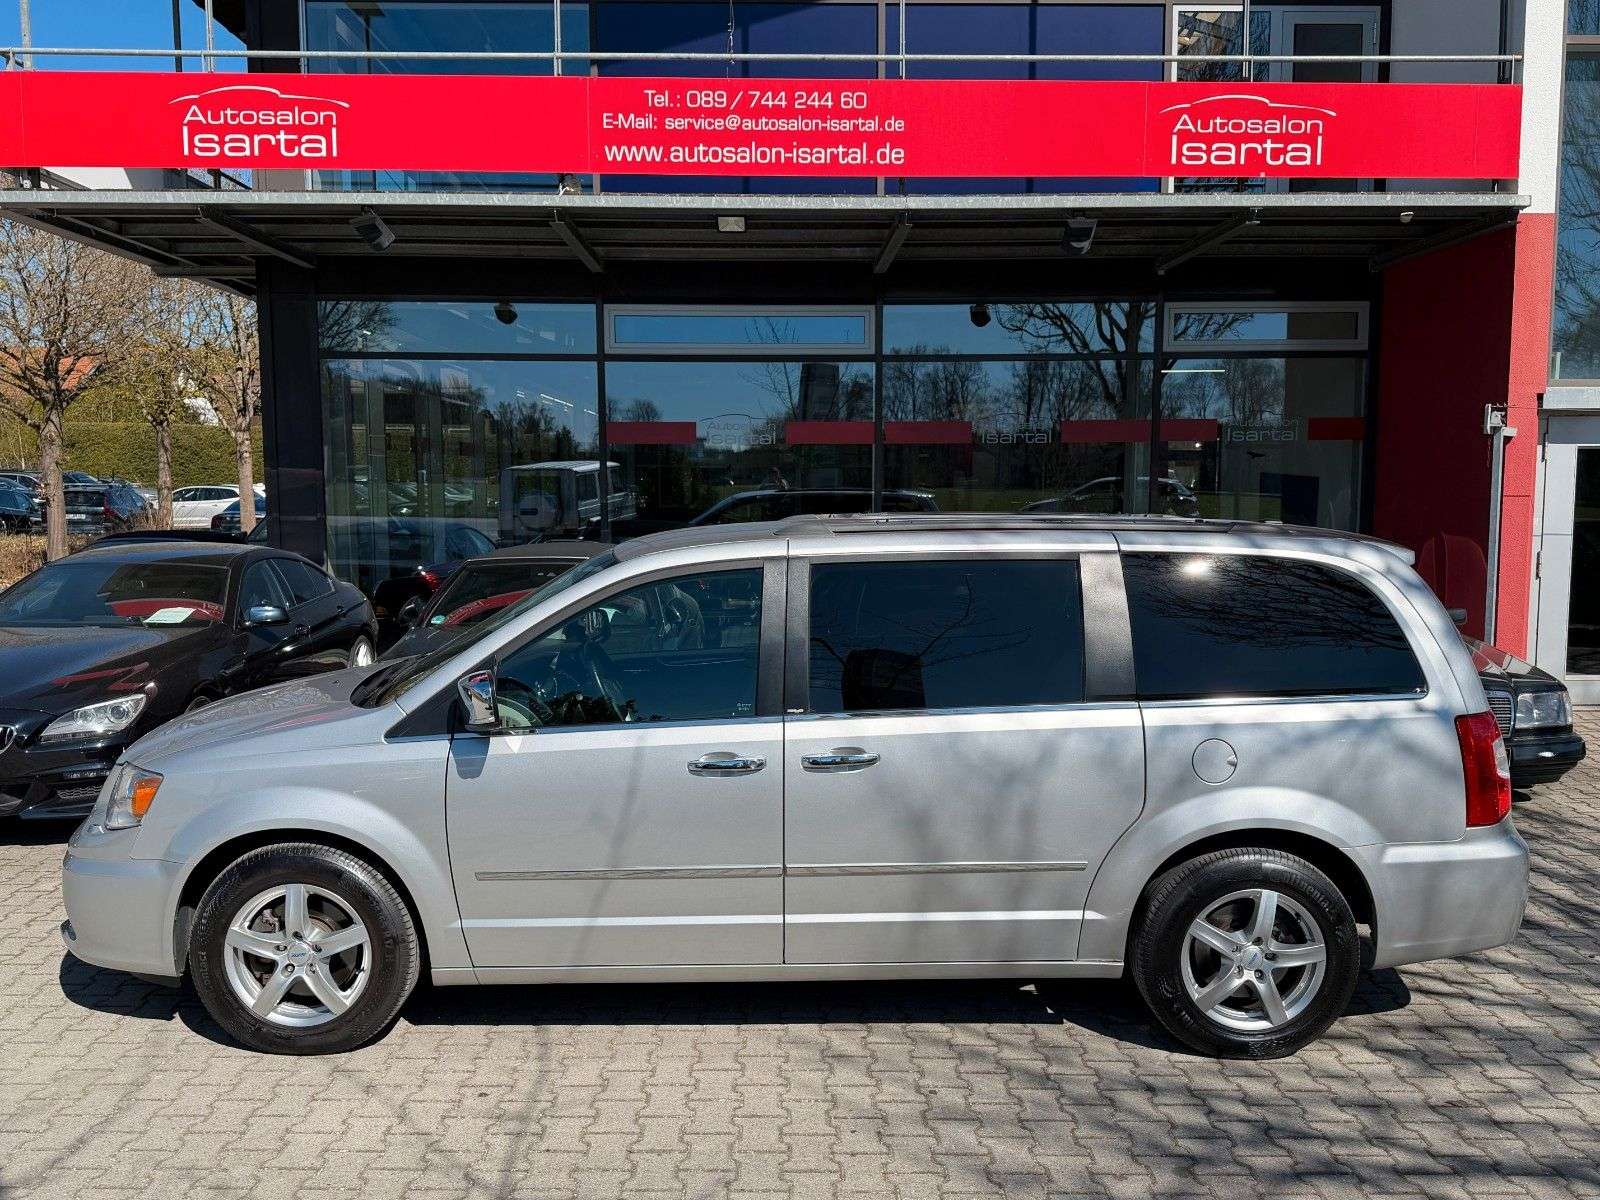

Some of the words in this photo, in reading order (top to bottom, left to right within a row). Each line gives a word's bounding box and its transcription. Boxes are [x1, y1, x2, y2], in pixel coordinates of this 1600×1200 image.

[643, 89, 681, 108] Tel.:
[794, 91, 833, 109] 244
[840, 91, 867, 109] 60
[183, 104, 337, 125] Autosalon
[602, 112, 658, 129] E-Mail:
[664, 114, 905, 132] service@autosalon-isartal.de
[1173, 113, 1323, 134] Autosalon
[182, 125, 338, 157] Isartal
[1171, 134, 1323, 166] Isartal
[604, 140, 905, 165] www.autosalon-isartal.de
[981, 429, 1052, 444] Isartal
[1227, 427, 1299, 442] Isartal
